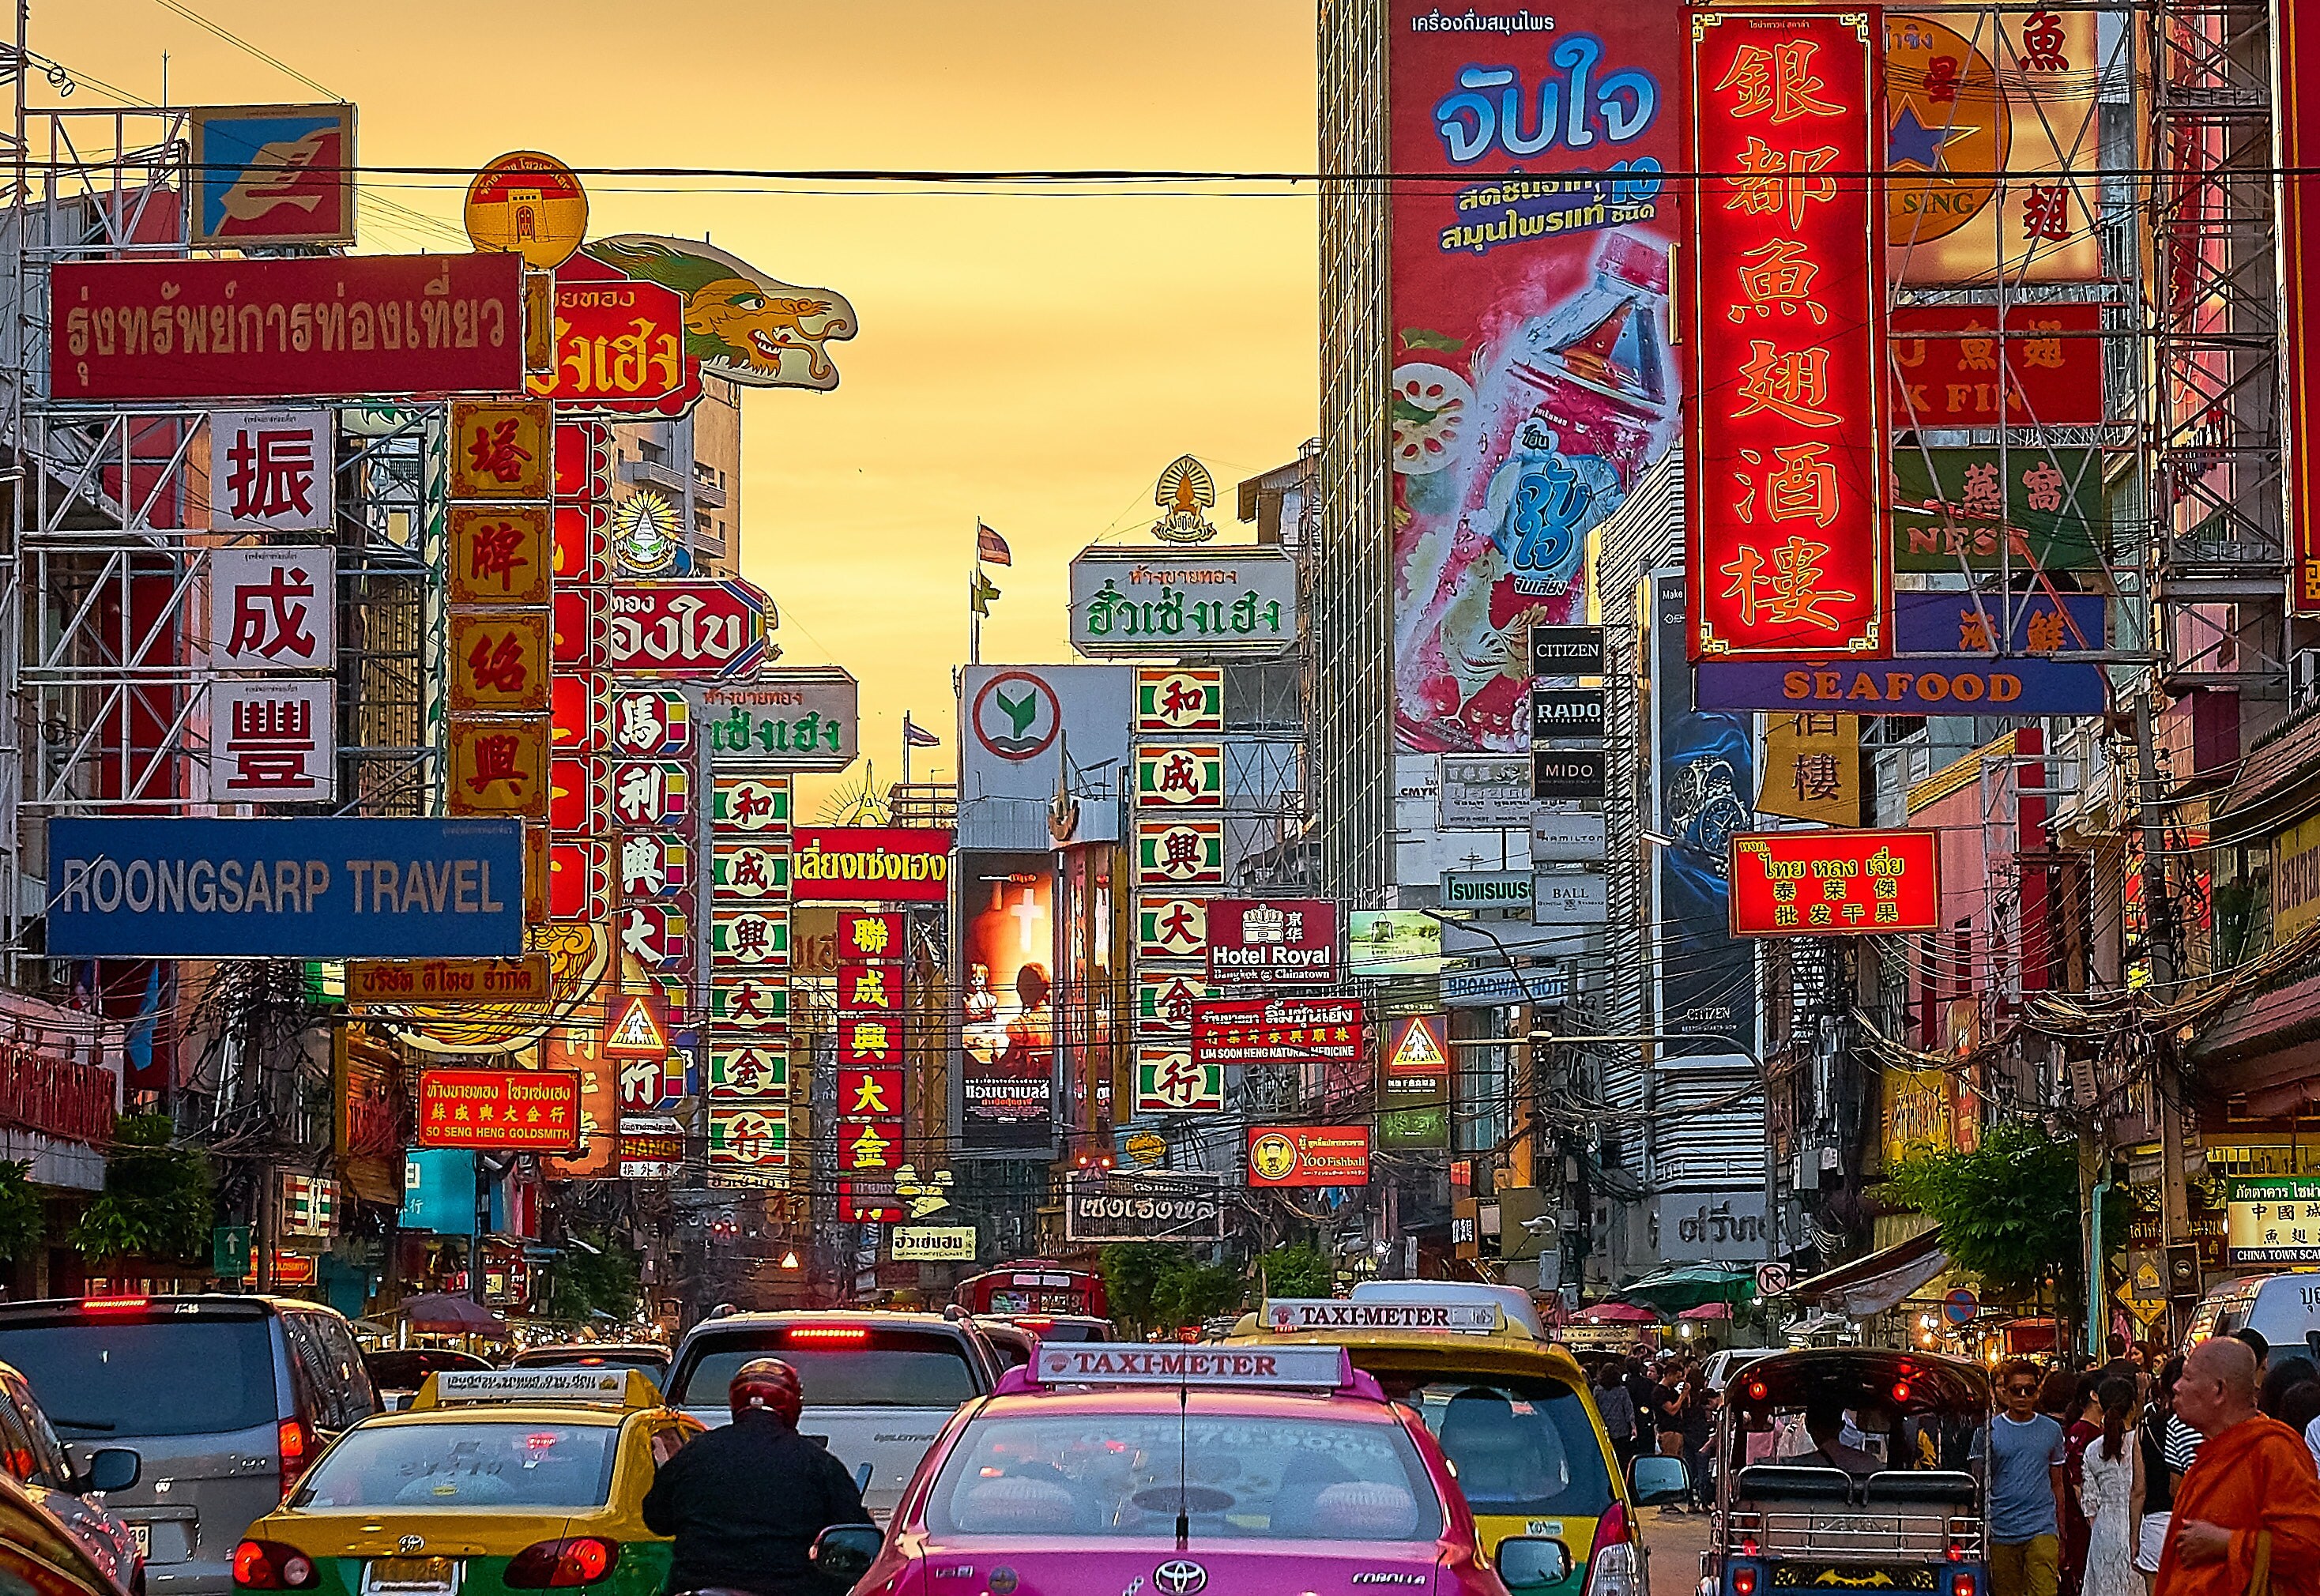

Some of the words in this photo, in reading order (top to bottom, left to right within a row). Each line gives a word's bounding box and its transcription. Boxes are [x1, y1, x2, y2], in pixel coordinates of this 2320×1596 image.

[1412, 9, 1554, 36] เครื่องดื่มสมุนไพร
[1437, 37, 1655, 161] จับใจ
[1904, 194, 1973, 214] SING
[555, 291, 635, 308] ยทอง
[67, 259, 505, 386] รุ่งทรัพย์การท่องเที่ยว
[1714, 40, 1855, 630] 銀都魚翅酒樓
[1946, 384, 2024, 412] FIN
[1128, 564, 1237, 585] ห้างขายทอง
[1536, 644, 1599, 657] CITIZEN
[1783, 671, 2022, 702] SEAFOOD
[1537, 703, 1601, 718] RADO
[1546, 764, 1593, 777] MIDO
[1759, 853, 1806, 879] ไทย
[1812, 859, 1858, 878] หลง
[1866, 846, 1905, 876] เจี่ย
[65, 858, 330, 914] ROONGSARP
[346, 860, 504, 913] TRAVEL
[1553, 887, 1589, 900] BALL
[619, 695, 665, 1104] 馬利興大行
[1775, 902, 1899, 926] 批发干果
[1213, 946, 1266, 965] Hotel
[1272, 946, 1330, 966] Royal
[1275, 969, 1331, 979] Chinatown
[1531, 978, 1569, 996] HOTE
[1686, 1007, 1731, 1020] CITIZEN
[1200, 1049, 1216, 1059] LIM
[1218, 1048, 1242, 1059] SOON
[1244, 1048, 1268, 1058] HENG
[427, 1079, 499, 1099] ห้างขายทอง
[426, 1127, 440, 1137] SO
[444, 1127, 473, 1138] SENG
[476, 1127, 505, 1139] HENG
[509, 1127, 570, 1139] GOLDSMITH
[1328, 1157, 1365, 1167] Fishball
[2235, 1184, 2288, 1199] ภัตตาคาร
[2263, 1228, 2320, 1245] 魚翅
[2237, 1251, 2266, 1261] CHINA
[2268, 1250, 2297, 1261] TOWN
[1301, 1306, 1450, 1327] TAXI-METER
[1073, 1352, 1278, 1376] TAXI-METER
